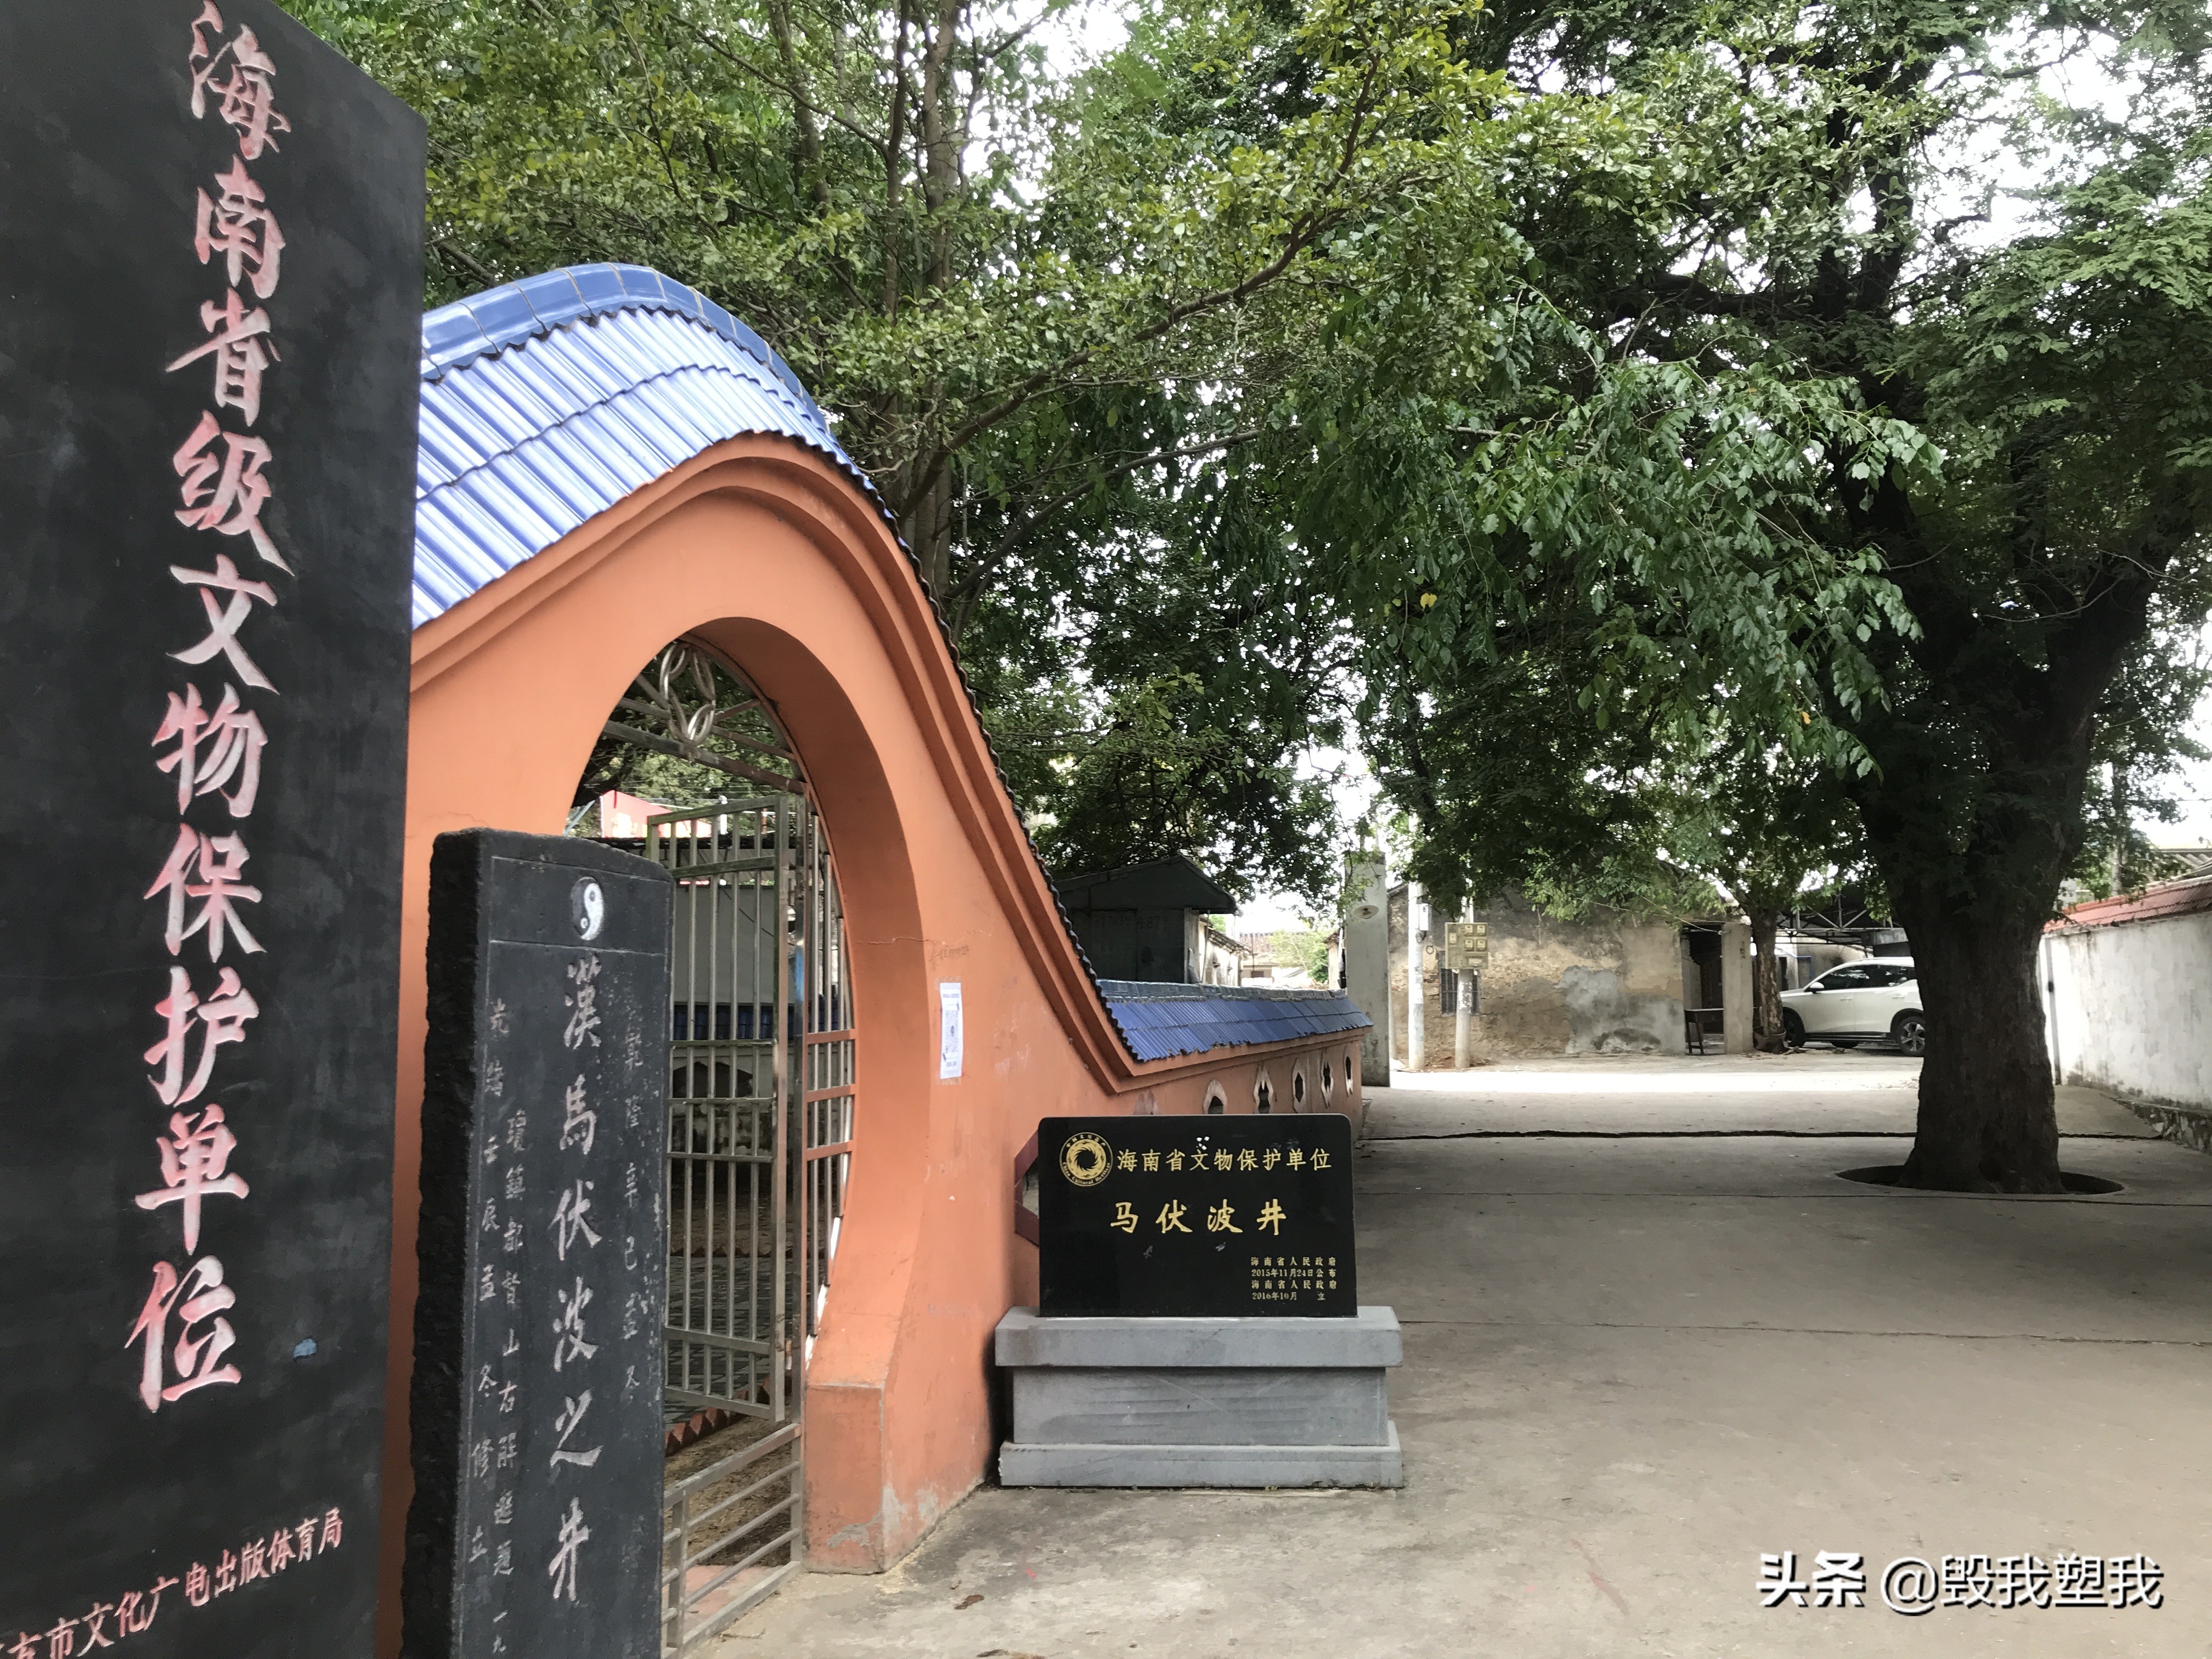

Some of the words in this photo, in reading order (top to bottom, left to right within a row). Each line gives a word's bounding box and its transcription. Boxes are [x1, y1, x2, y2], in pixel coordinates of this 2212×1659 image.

[125, 0, 295, 1413] 海南省级文物保护单位
[1117, 1149, 1332, 1172] 海南省文物保护单位
[1110, 1199, 1286, 1235] 马伏波井
[1250, 1256, 1336, 1266] 海南省人民政府
[1251, 1279, 1337, 1289] 海南省人民政府
